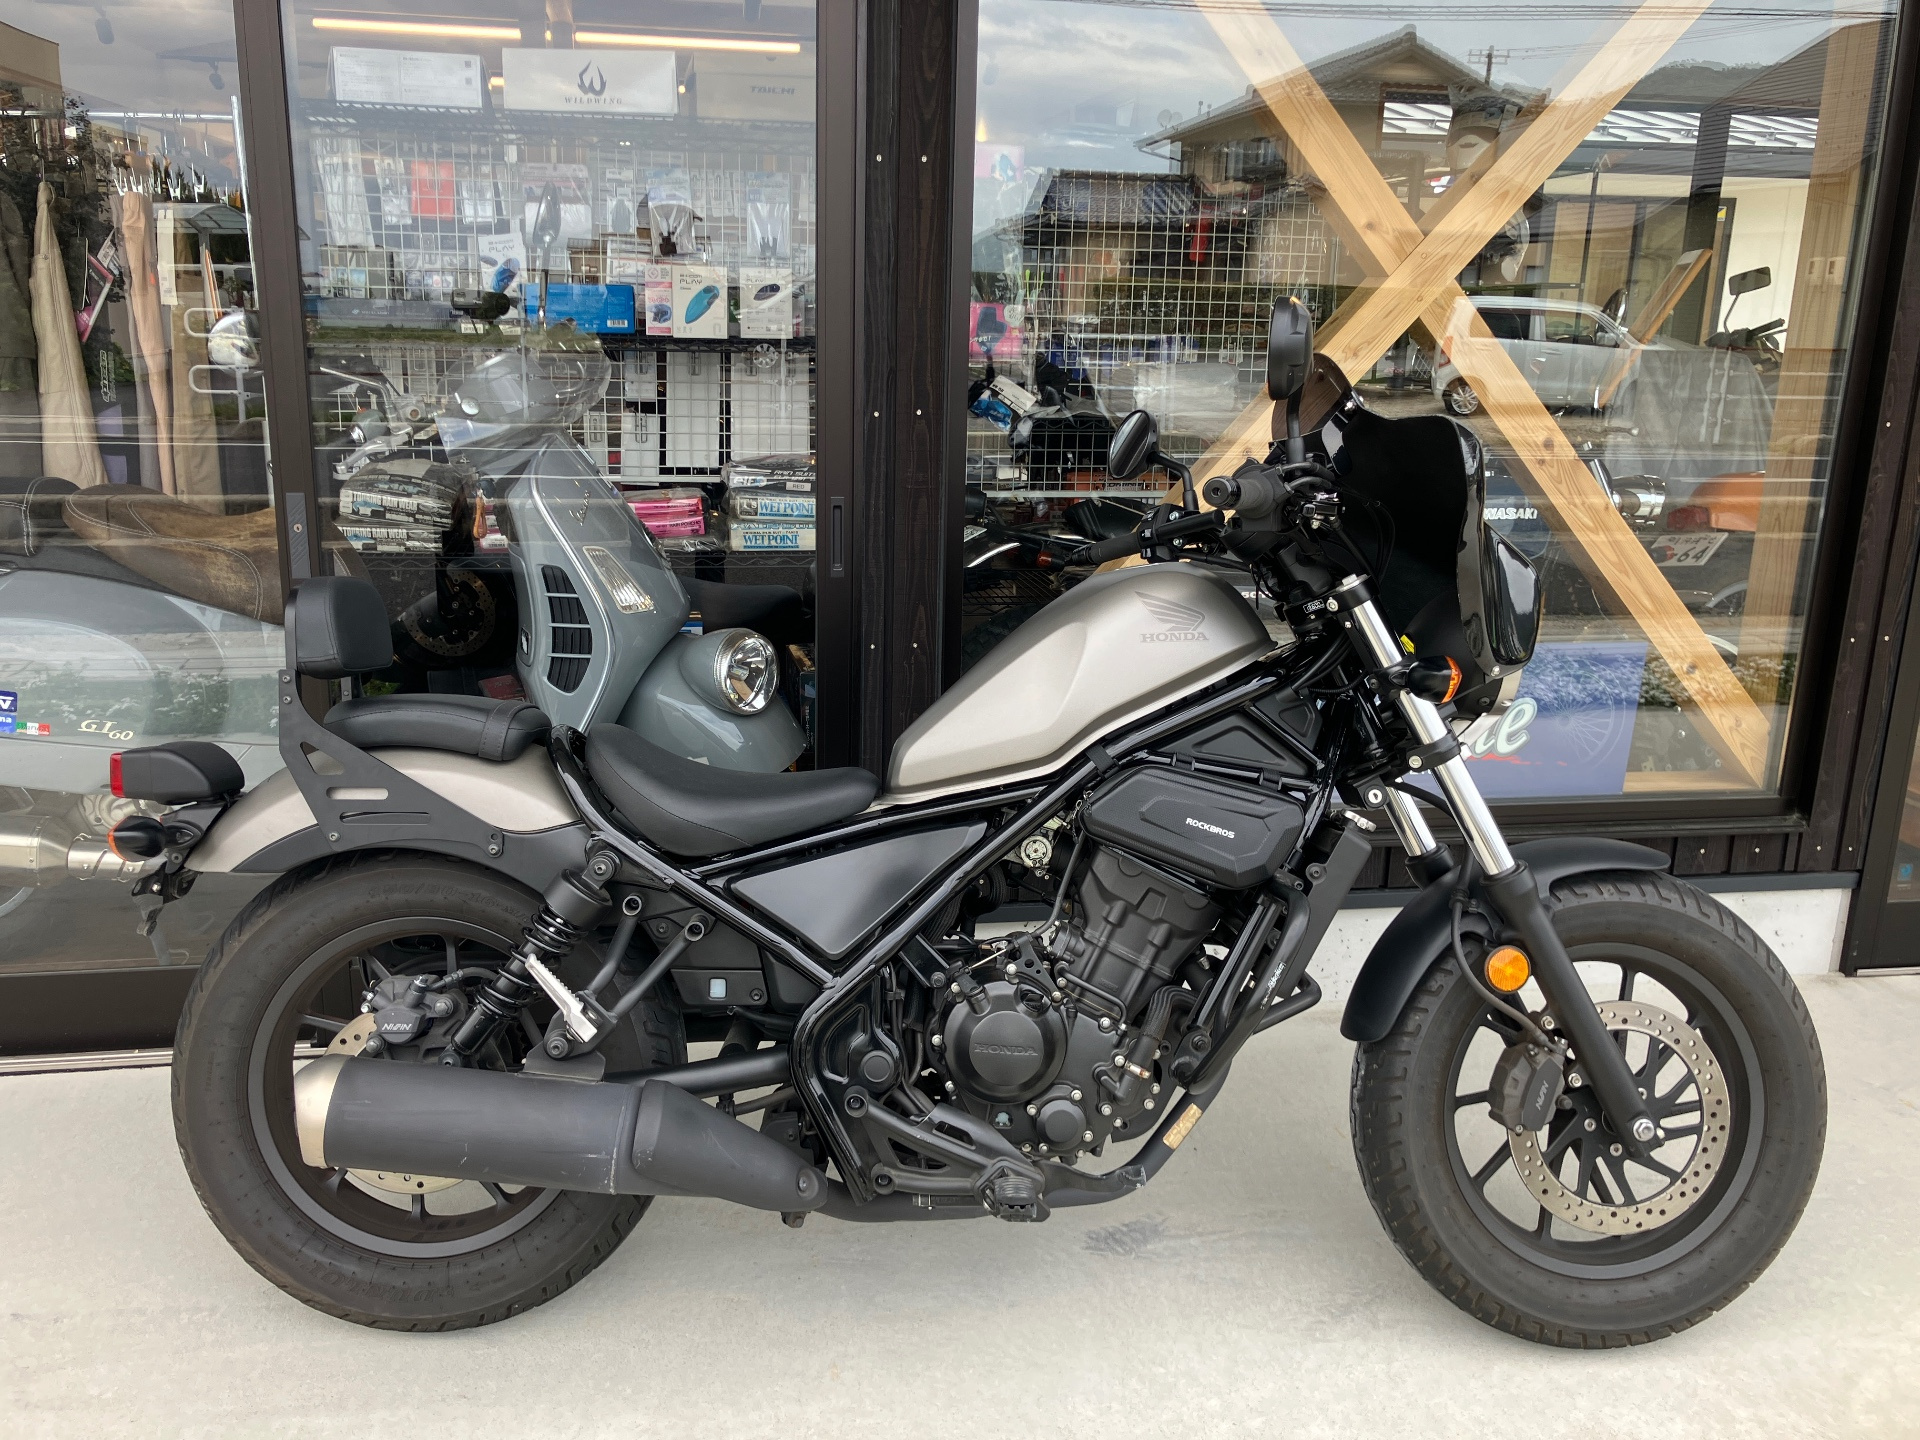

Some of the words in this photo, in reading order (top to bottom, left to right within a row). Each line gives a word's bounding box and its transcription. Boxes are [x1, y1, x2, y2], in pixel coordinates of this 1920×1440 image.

[564, 96, 622, 105] WILDWING
[382, 496, 398, 507] RAIN
[758, 501, 782, 513] WET
[372, 527, 388, 538] RAIN
[388, 528, 407, 539] WEAR
[743, 534, 767, 545] WET
[768, 534, 799, 545] POINT
[1140, 632, 1209, 643] HONDA
[1185, 817, 1235, 839] ROCKBROS
[974, 1043, 1038, 1056] HONDA
